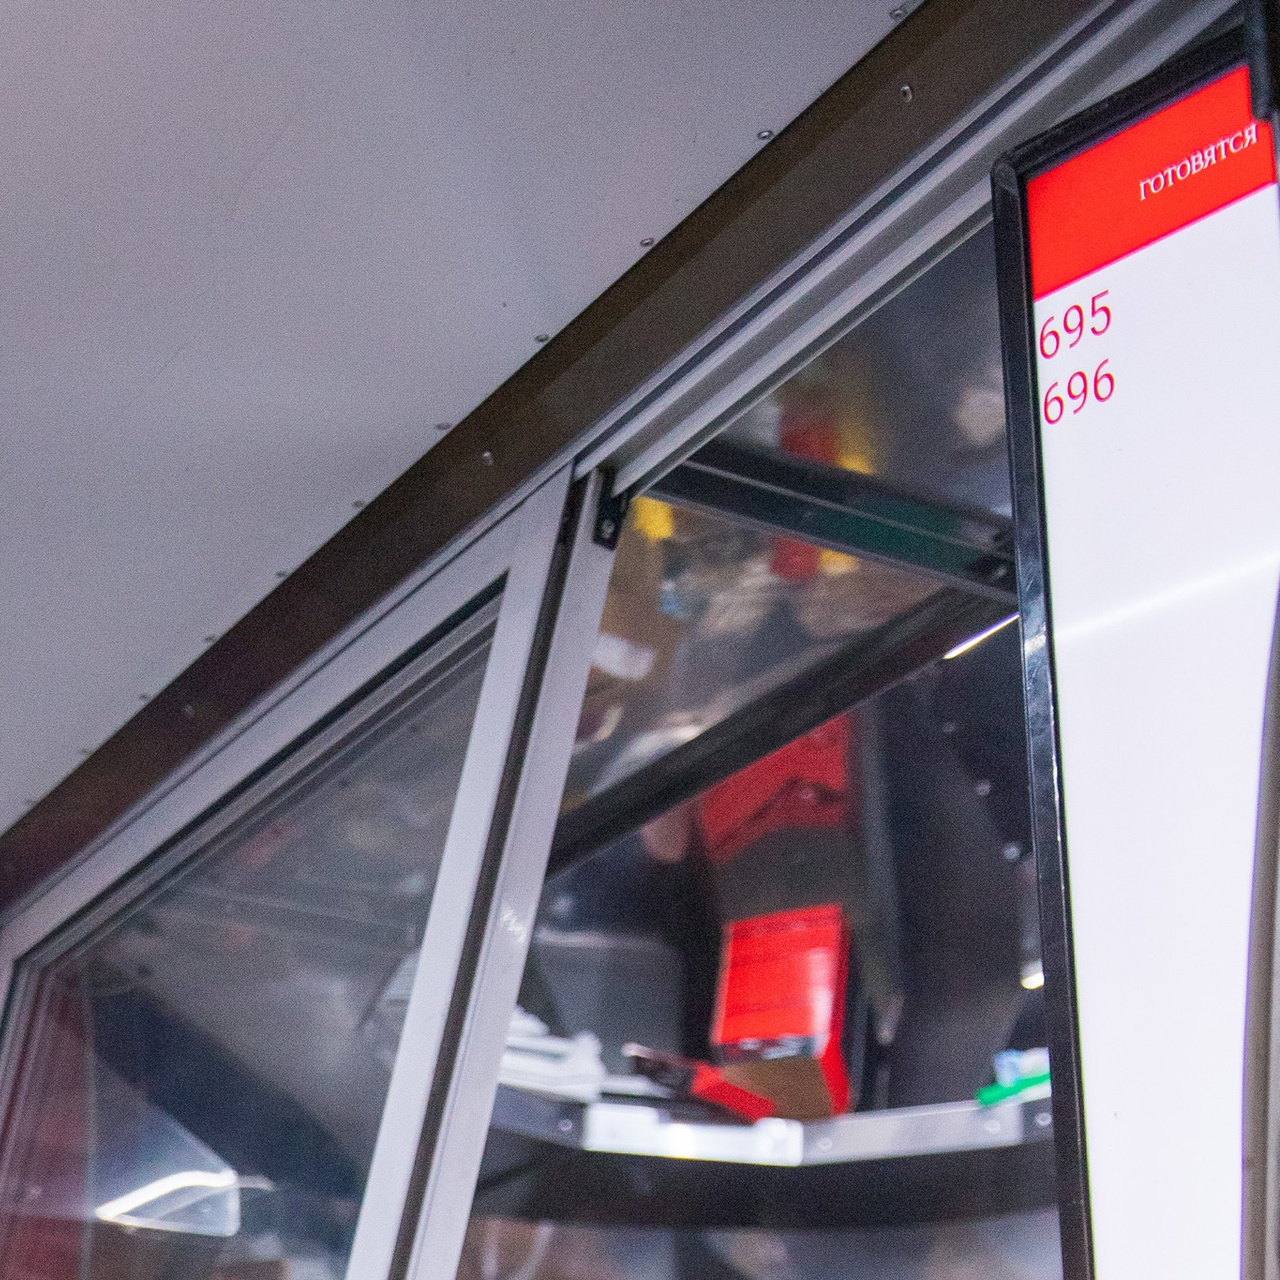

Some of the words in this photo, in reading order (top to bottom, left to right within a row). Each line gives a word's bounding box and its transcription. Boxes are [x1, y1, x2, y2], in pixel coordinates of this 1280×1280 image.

[1139, 123, 1257, 201] ГОТОВЯТСЯ
[1039, 289, 1112, 360] 695
[1043, 358, 1115, 425] 696
